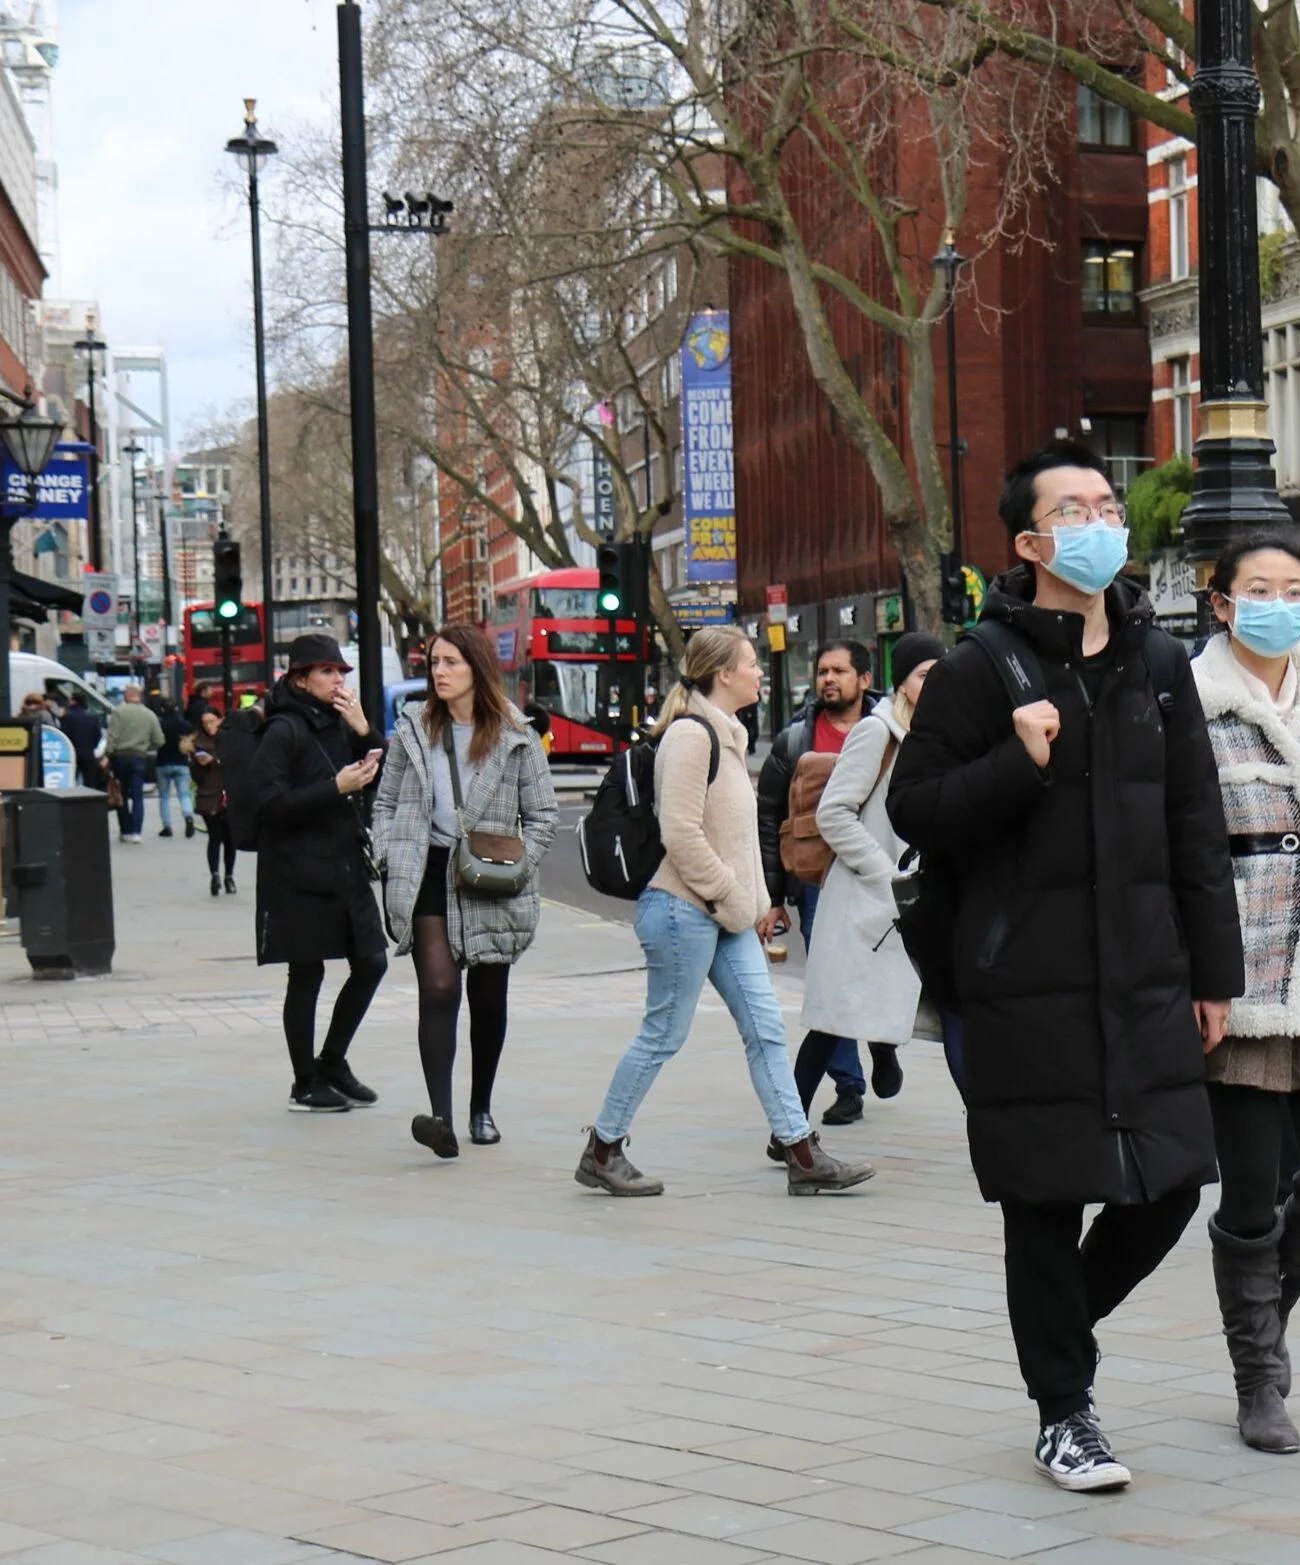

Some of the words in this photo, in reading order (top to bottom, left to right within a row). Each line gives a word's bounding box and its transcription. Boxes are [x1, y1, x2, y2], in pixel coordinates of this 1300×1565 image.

[689, 425, 734, 450] FROM
[8, 473, 83, 489] CHANGE
[598, 452, 614, 530] HOEN
[8, 486, 83, 504] MNEY
[691, 491, 712, 511] WE
